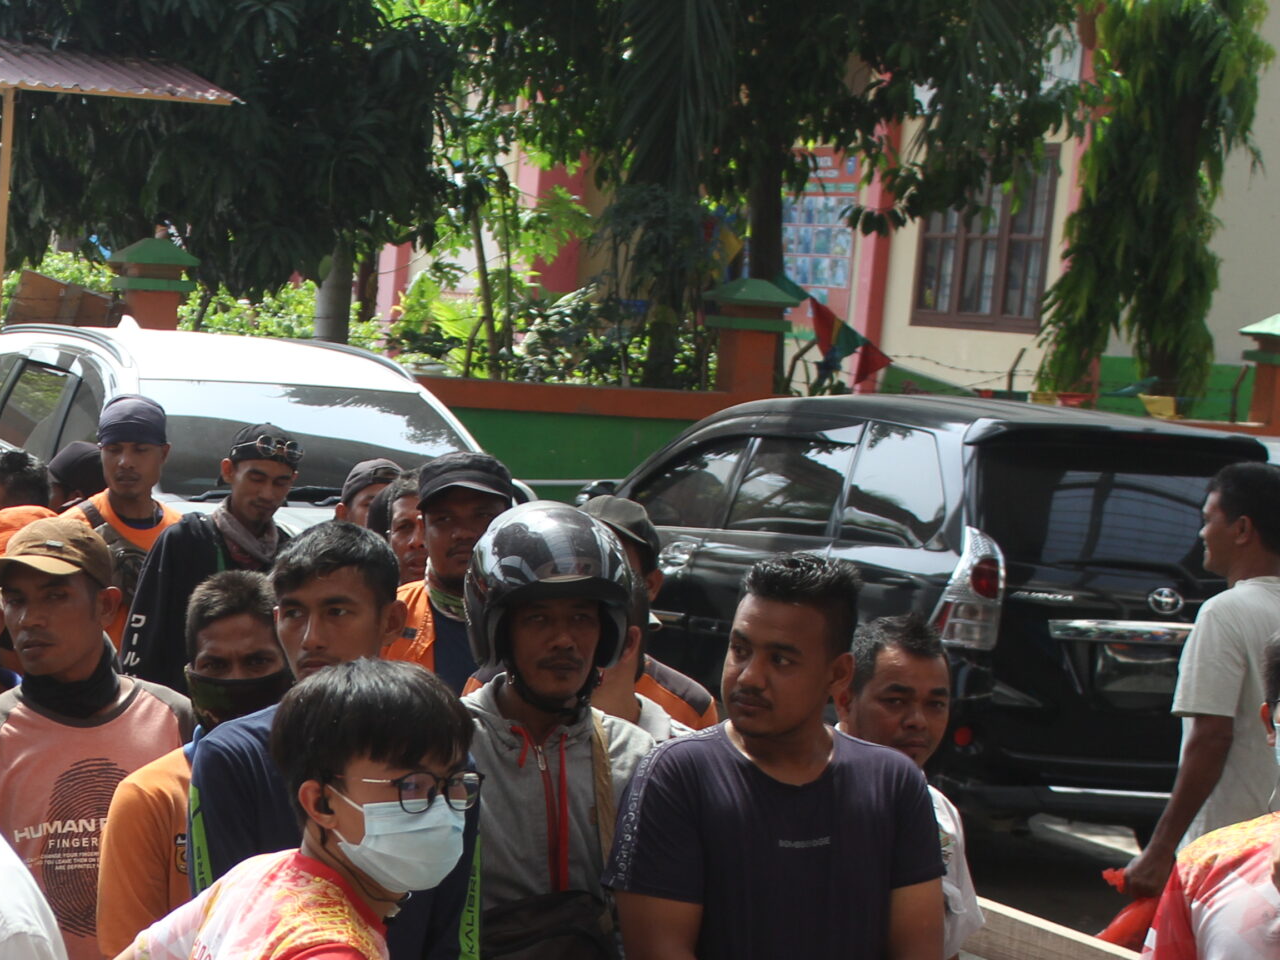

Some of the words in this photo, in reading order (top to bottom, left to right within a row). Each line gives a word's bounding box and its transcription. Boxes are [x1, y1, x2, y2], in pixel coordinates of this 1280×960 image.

[123, 613, 147, 677] ワール
[14, 819, 96, 842] HUMAN
[49, 837, 98, 848] FINGER
